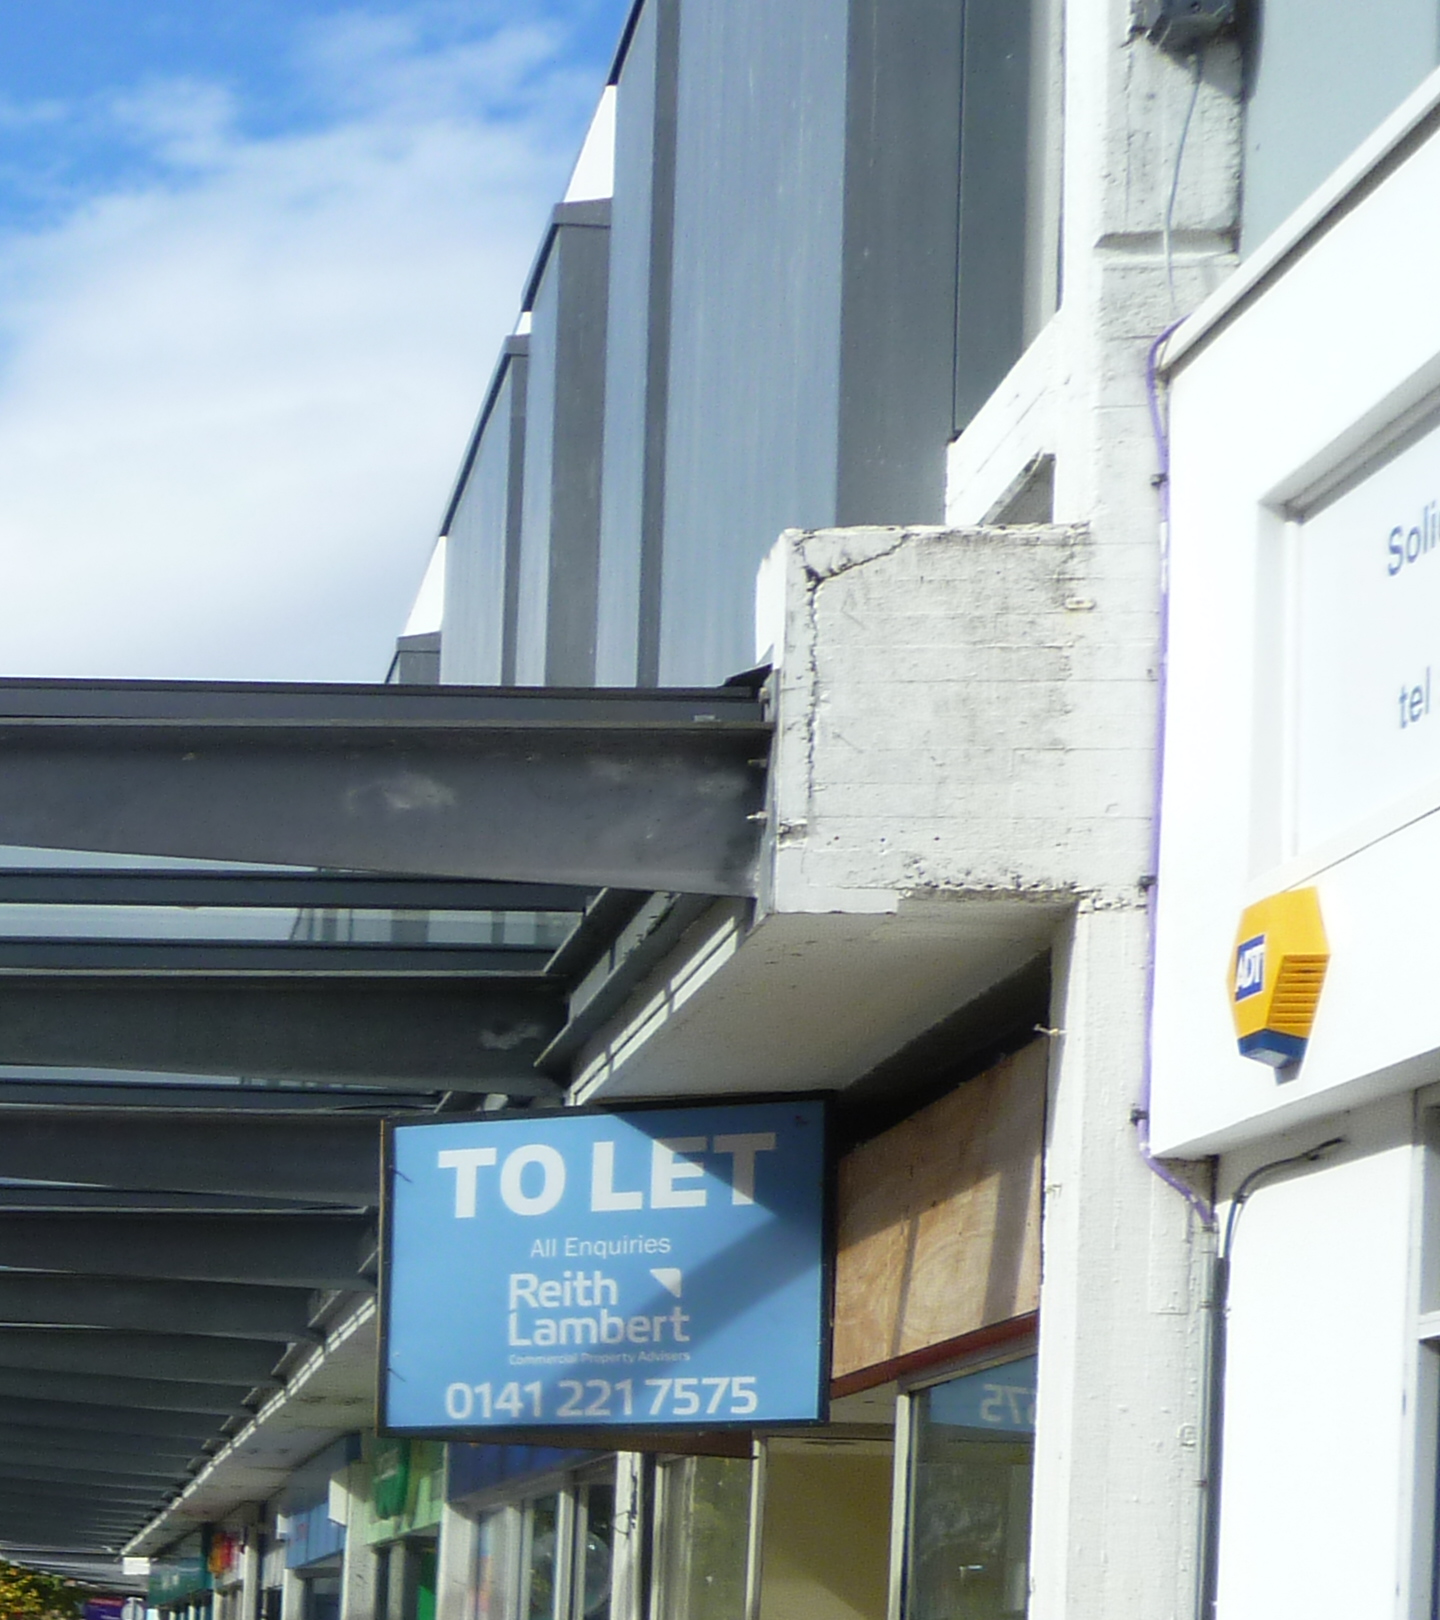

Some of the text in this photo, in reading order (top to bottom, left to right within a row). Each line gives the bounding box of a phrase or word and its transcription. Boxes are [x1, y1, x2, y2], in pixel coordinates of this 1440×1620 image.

[1386, 499, 1440, 578] Soli
[1398, 664, 1431, 730] tel
[1235, 943, 1266, 993] ADT
[438, 1132, 776, 1219] TO LET
[530, 1235, 672, 1260] All Enquiries
[509, 1270, 618, 1311] Reith
[508, 1306, 690, 1347] Lambert
[445, 1375, 759, 1419] 0141 221 7575
